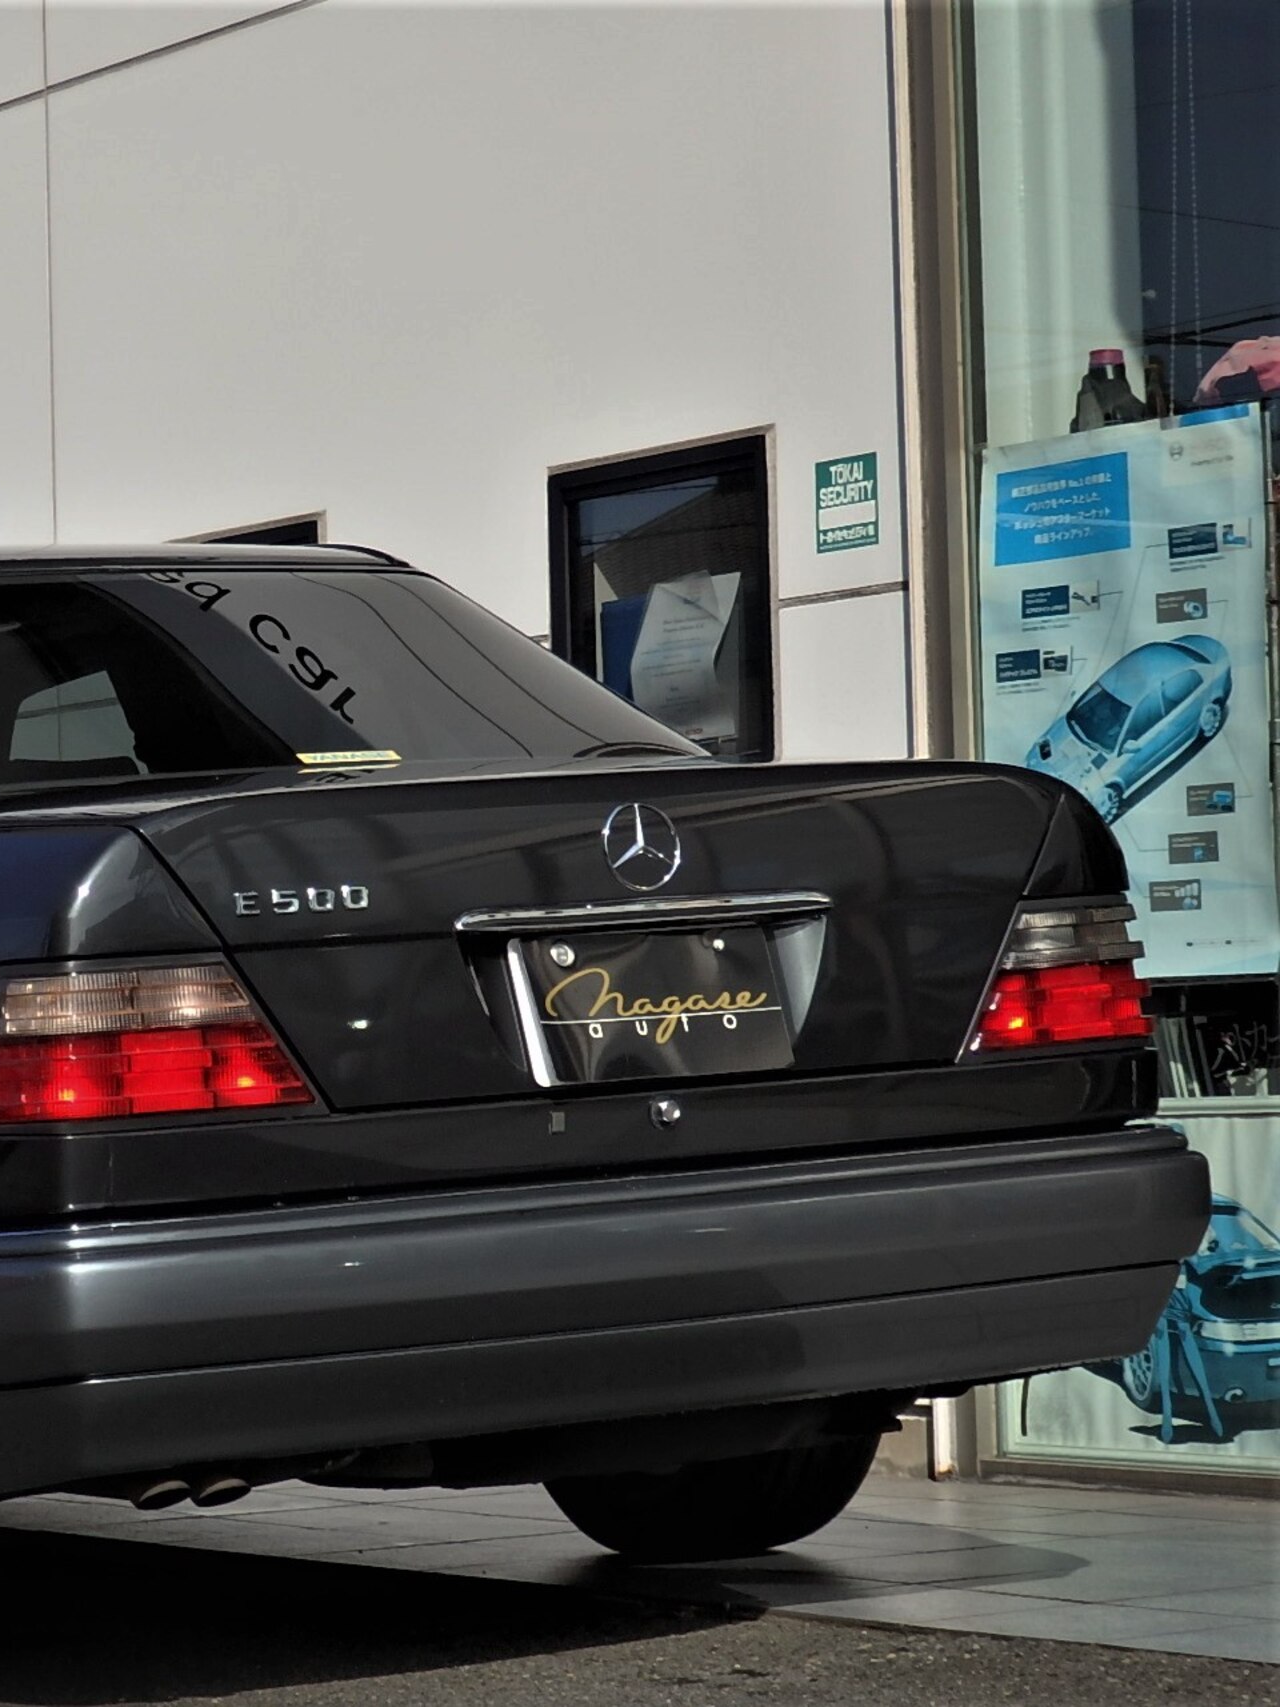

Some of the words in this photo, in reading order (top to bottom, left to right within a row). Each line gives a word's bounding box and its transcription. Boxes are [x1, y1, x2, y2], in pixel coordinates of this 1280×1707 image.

[829, 461, 864, 485] TOKAI
[819, 479, 874, 508] SECURITY
[232, 884, 369, 917] E500
[545, 967, 768, 1044] Nagase
